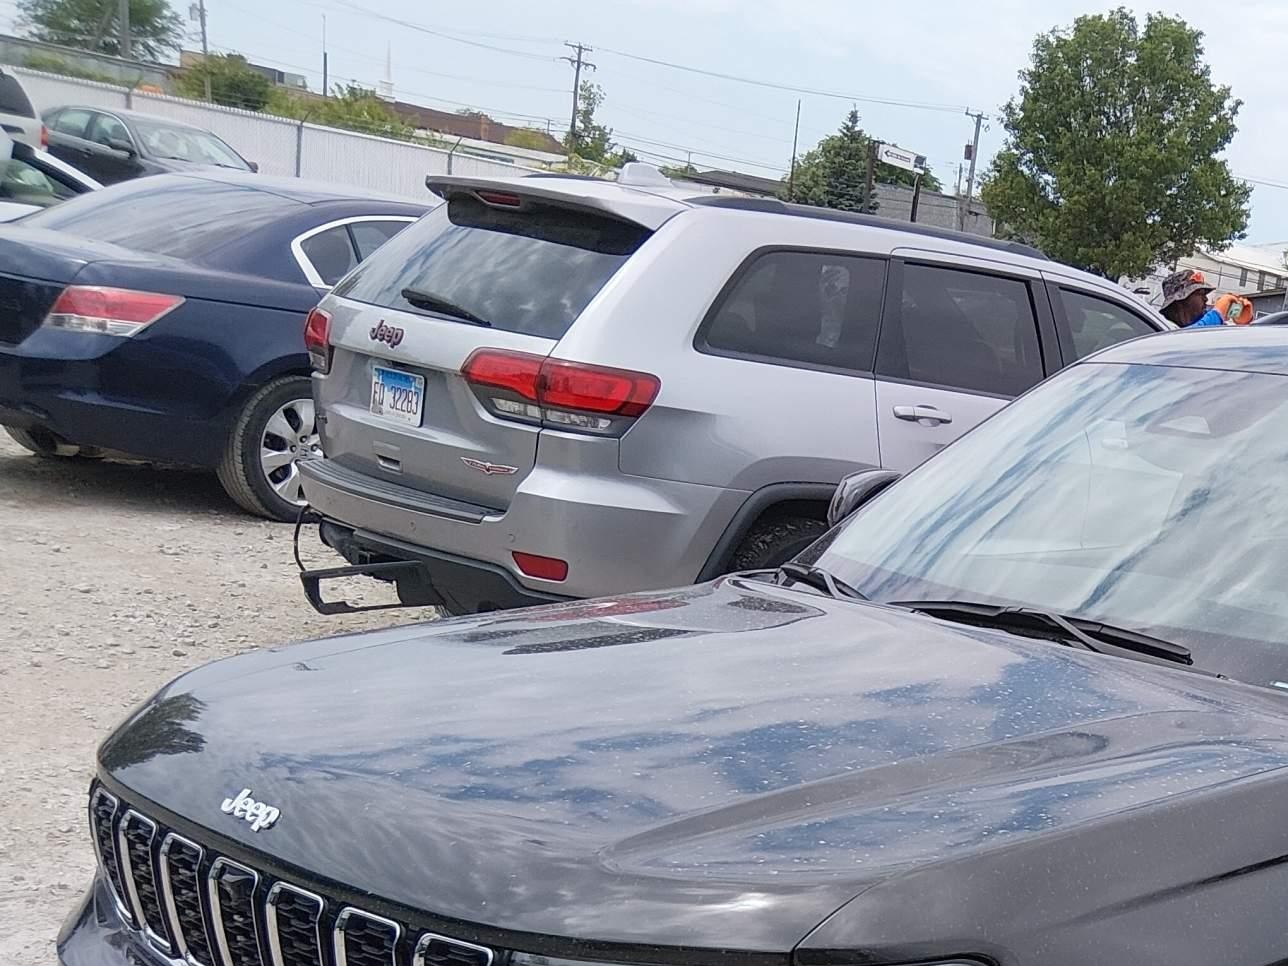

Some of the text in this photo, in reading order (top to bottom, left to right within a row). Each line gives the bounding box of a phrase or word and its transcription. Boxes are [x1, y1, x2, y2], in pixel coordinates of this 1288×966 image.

[369, 319, 405, 348] Jeep
[390, 385, 420, 415] 32283
[221, 788, 281, 832] Jeep
